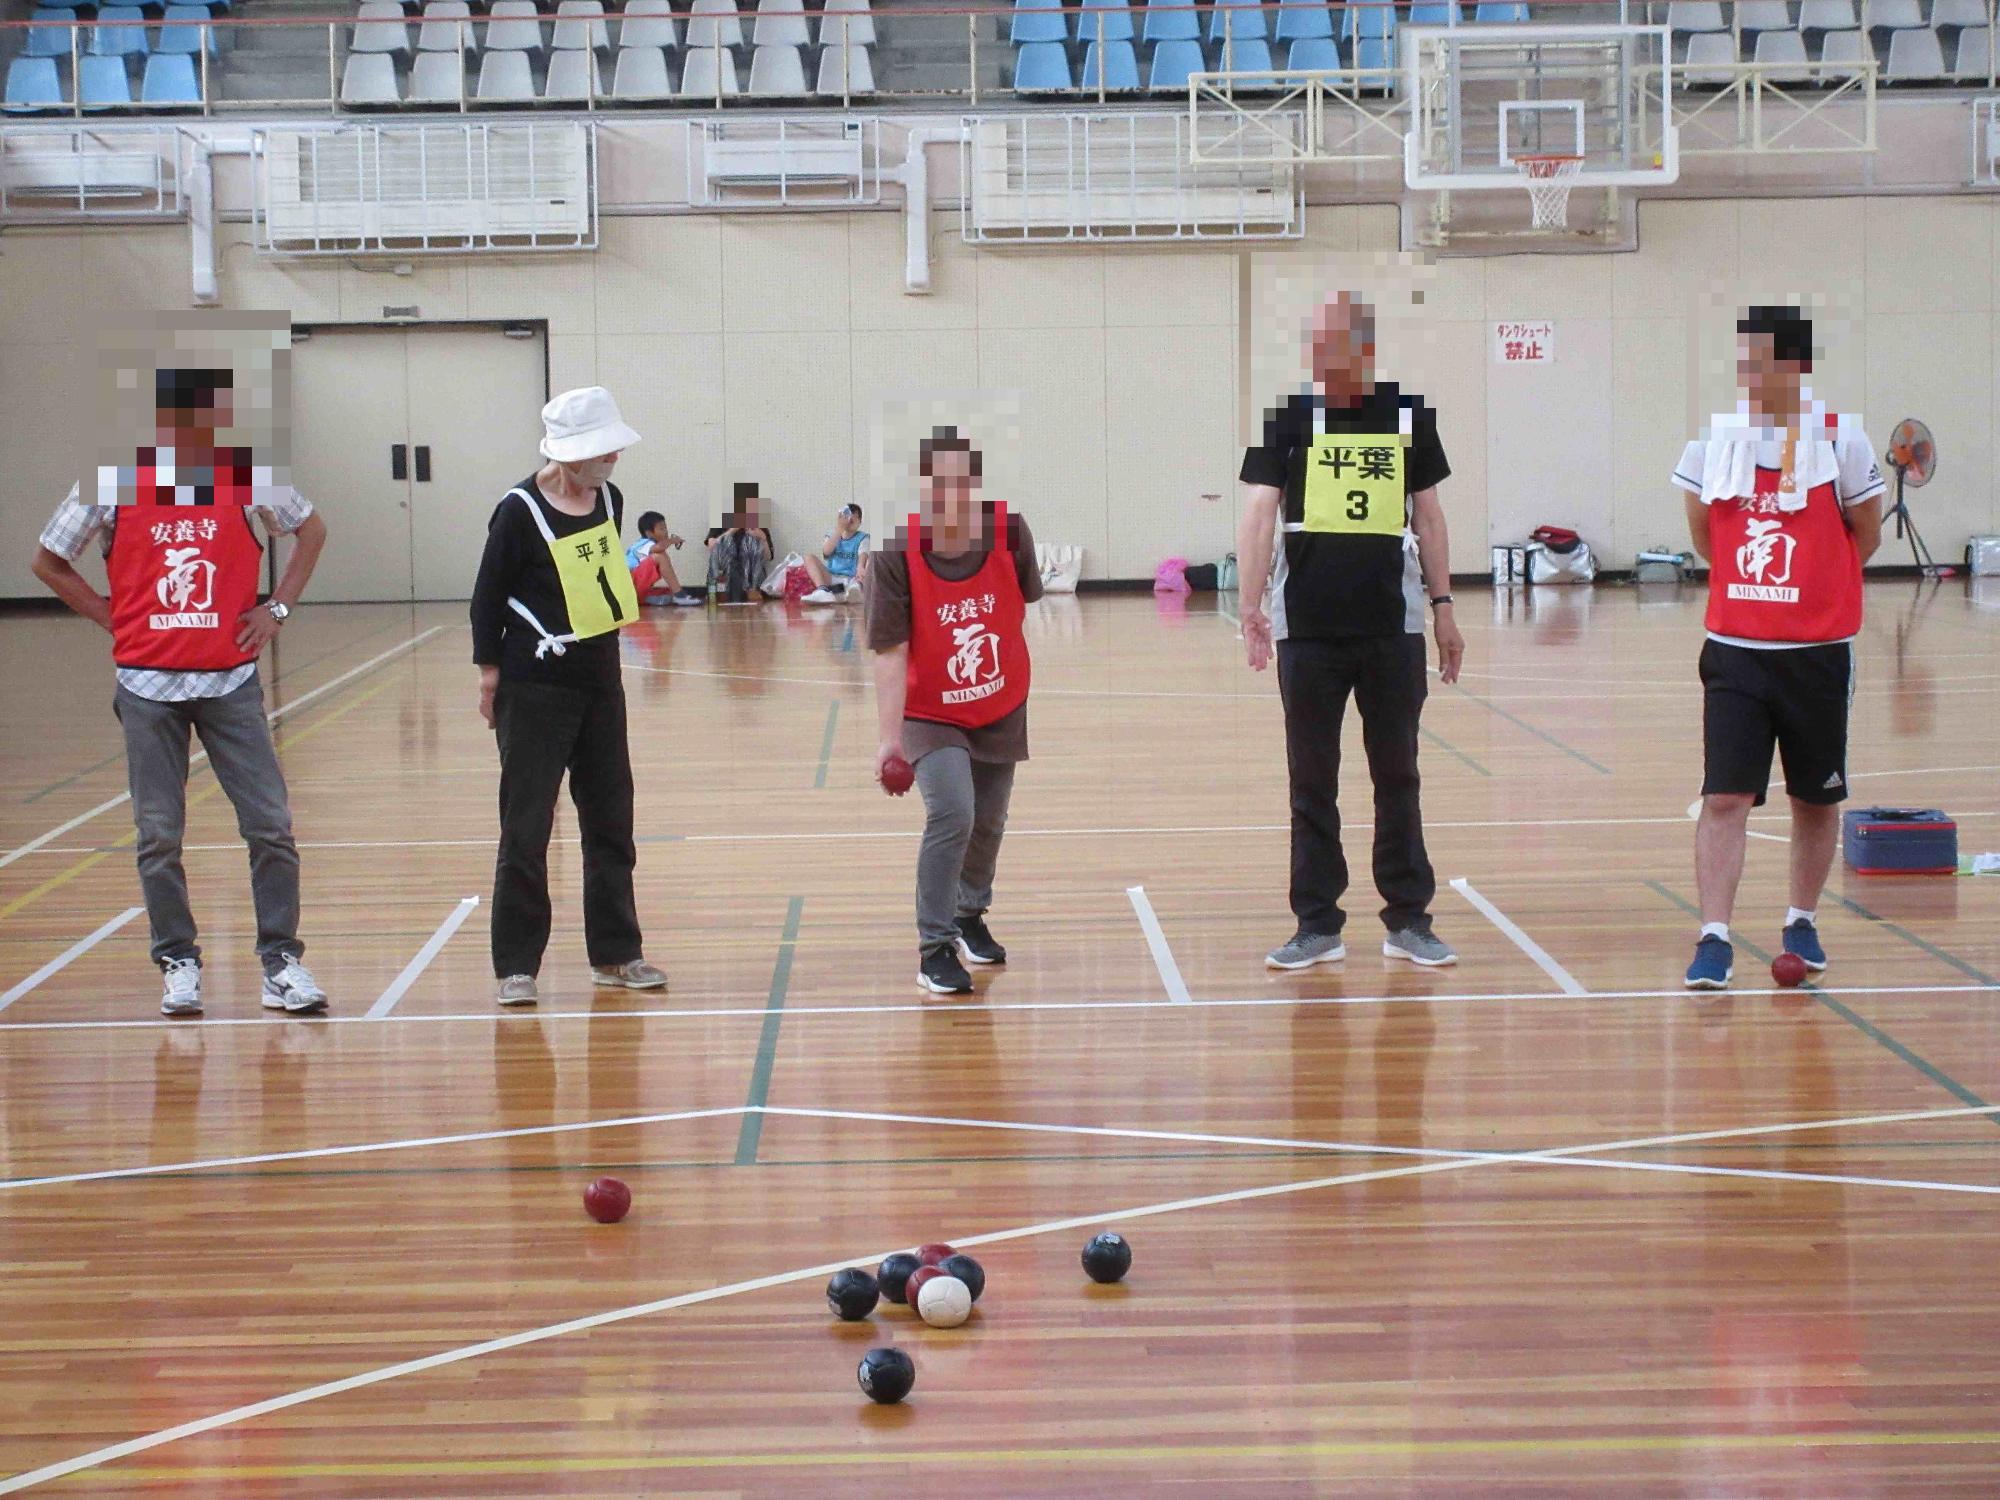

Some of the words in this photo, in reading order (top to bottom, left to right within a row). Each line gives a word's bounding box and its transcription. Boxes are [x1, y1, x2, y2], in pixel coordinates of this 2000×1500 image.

[1505, 341, 1544, 360] 禁止
[1346, 490, 1369, 521] 3
[151, 518, 218, 545] 安養寺
[1736, 517, 1797, 584] 南
[157, 547, 216, 611] 南
[596, 566, 624, 622] 1
[1736, 585, 1792, 600] MINAMI
[157, 614, 214, 627] MINAMI
[936, 594, 996, 626] 安養寺
[947, 623, 1000, 686] 南
[949, 680, 1001, 702] MINAMI
